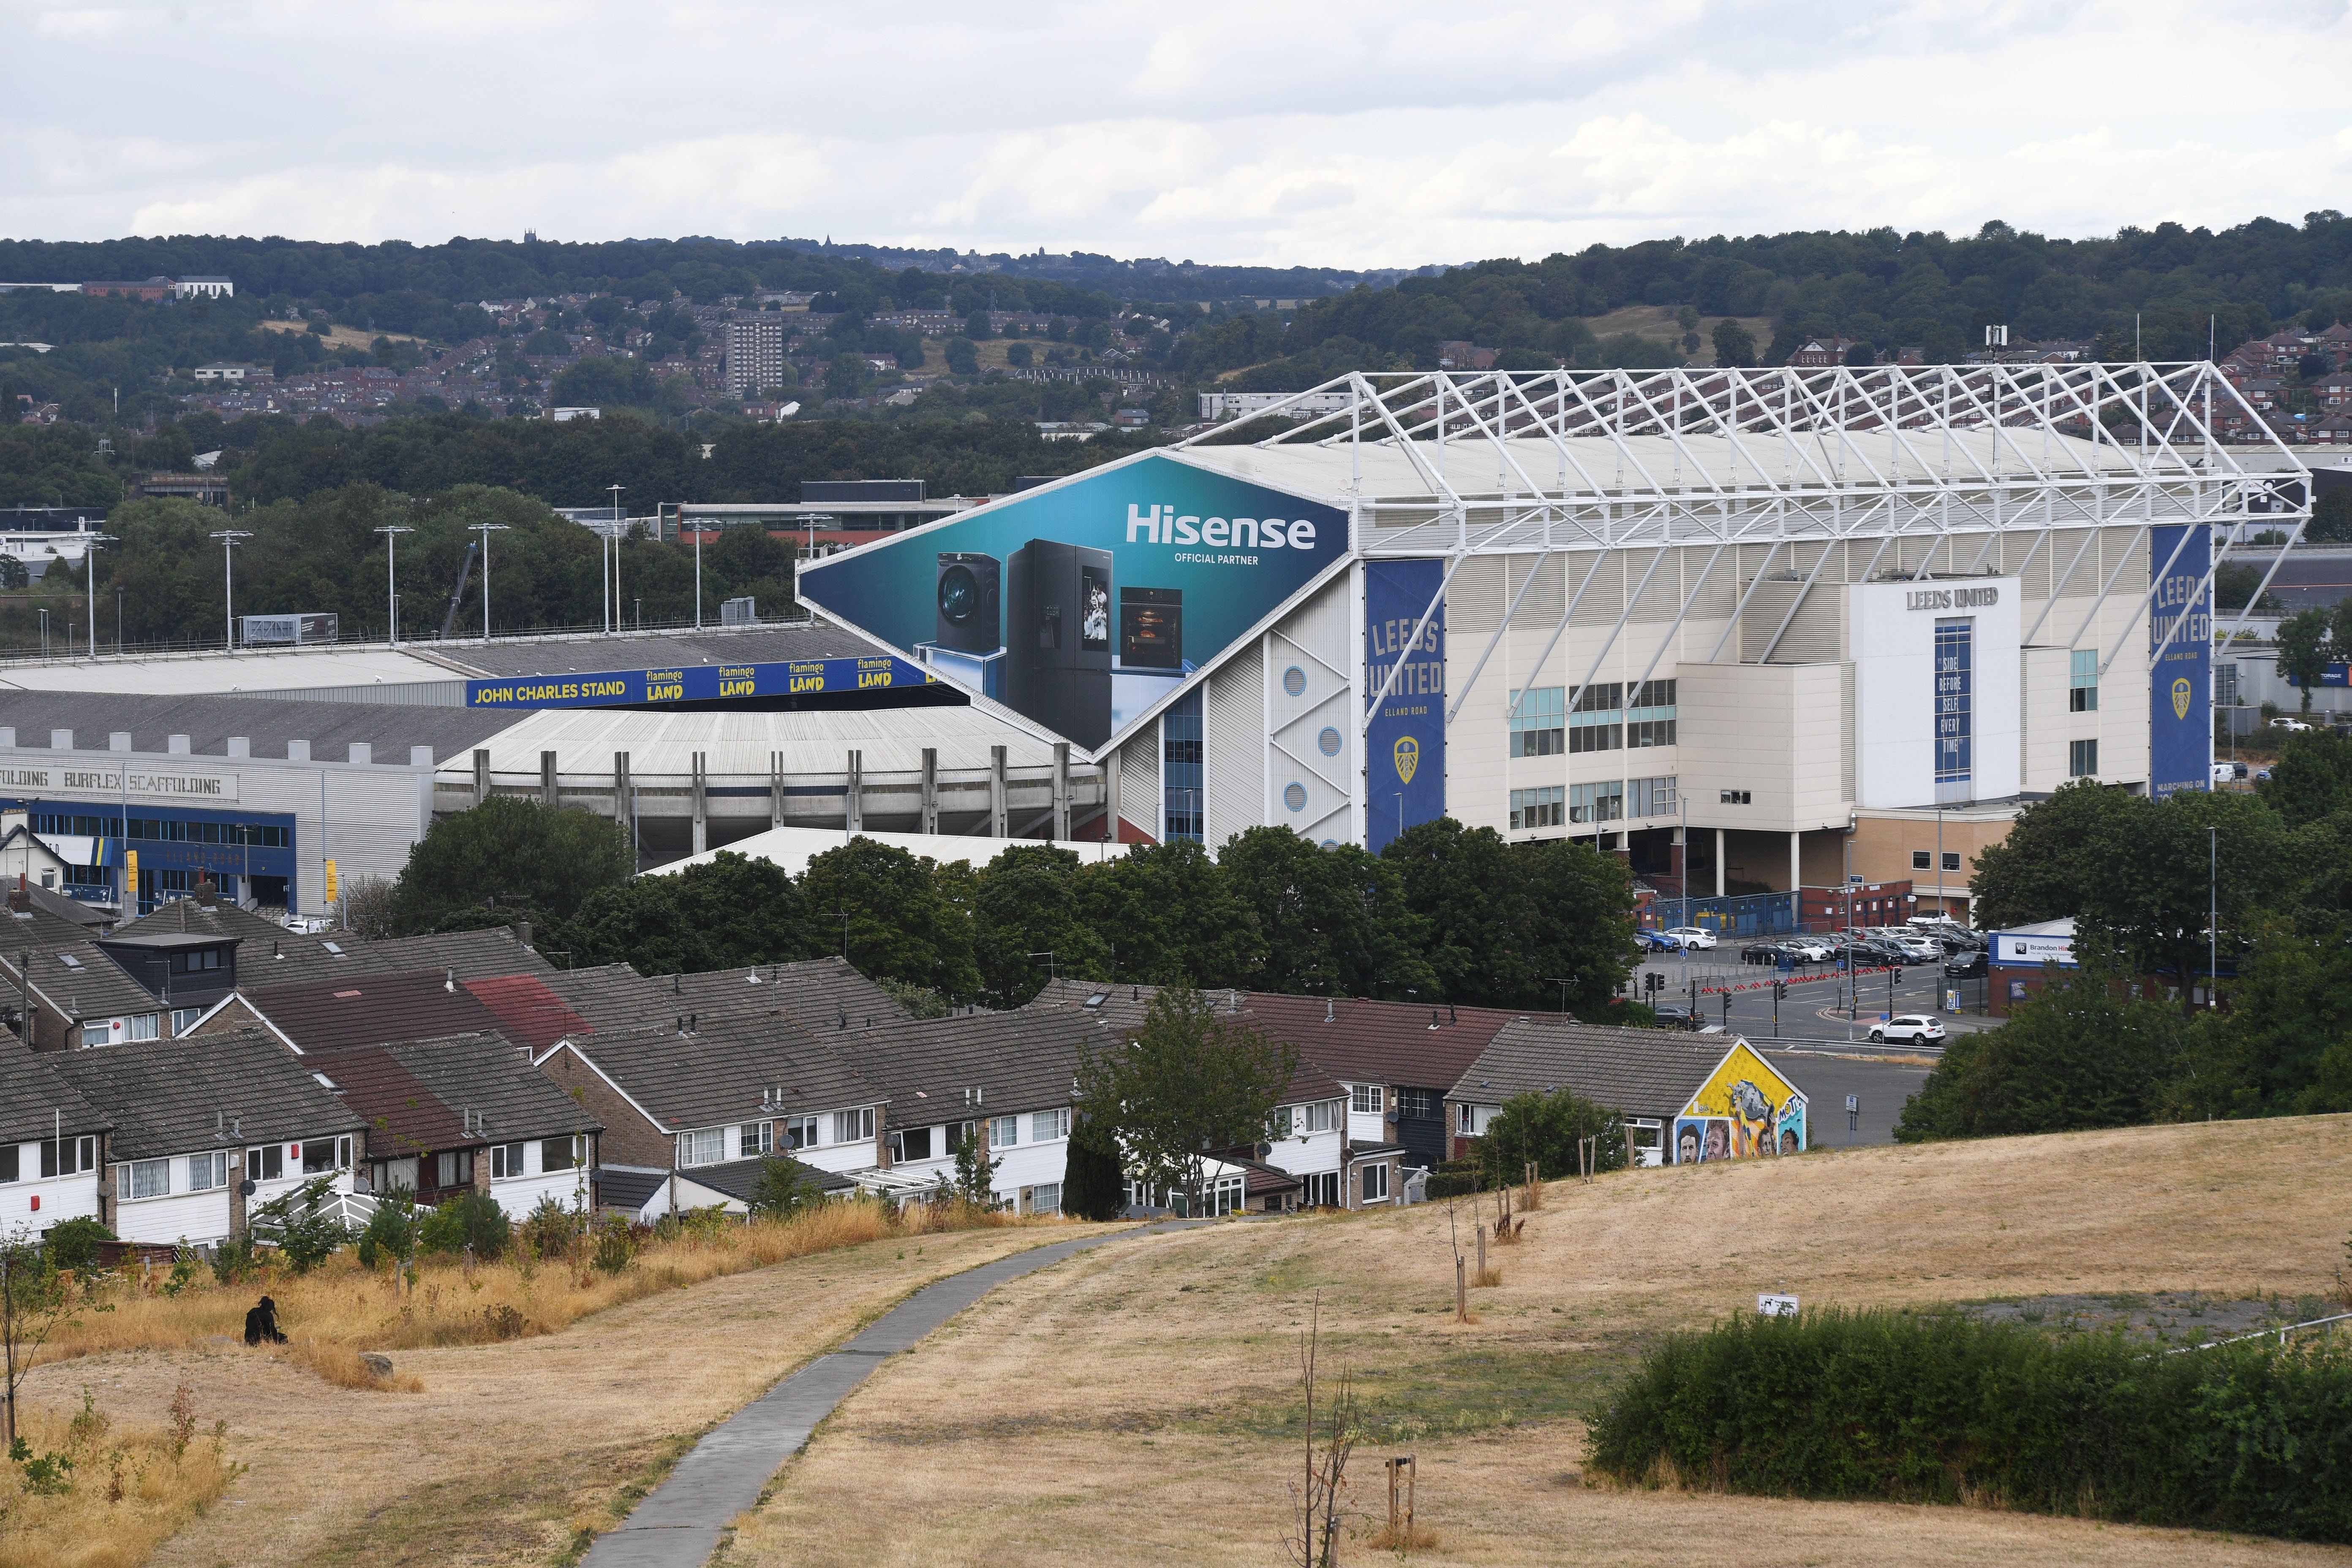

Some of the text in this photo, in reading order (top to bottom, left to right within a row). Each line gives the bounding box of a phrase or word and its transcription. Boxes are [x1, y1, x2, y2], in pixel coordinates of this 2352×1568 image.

[1126, 504, 1316, 549] Hisense
[1175, 553, 1258, 565] OFFICIAL PARTNER
[1907, 587, 1998, 610] LEEDS UNITED
[2157, 576, 2205, 609] LEEDS
[1372, 618, 1439, 656] LEEDS
[789, 662, 824, 674] flamingo
[858, 657, 891, 670] flamingo
[646, 669, 683, 682] flamingo
[719, 665, 754, 678] flamingo
[789, 677, 825, 692] LAND
[858, 672, 892, 688] LAND
[1370, 662, 1441, 697] UNITED
[1939, 677, 1961, 691] BEFORE
[475, 681, 625, 703] JOHN CHARLES STAND
[647, 685, 683, 701] LAND
[720, 681, 755, 696] LAND
[1385, 706, 1427, 716] ELLAND ROAD
[1941, 718, 1960, 732] EVERY
[0, 770, 48, 786] OLDING
[64, 772, 220, 794] BURFLEX SCAFFOLDING
[2157, 780, 2205, 792] MARCHING ON
